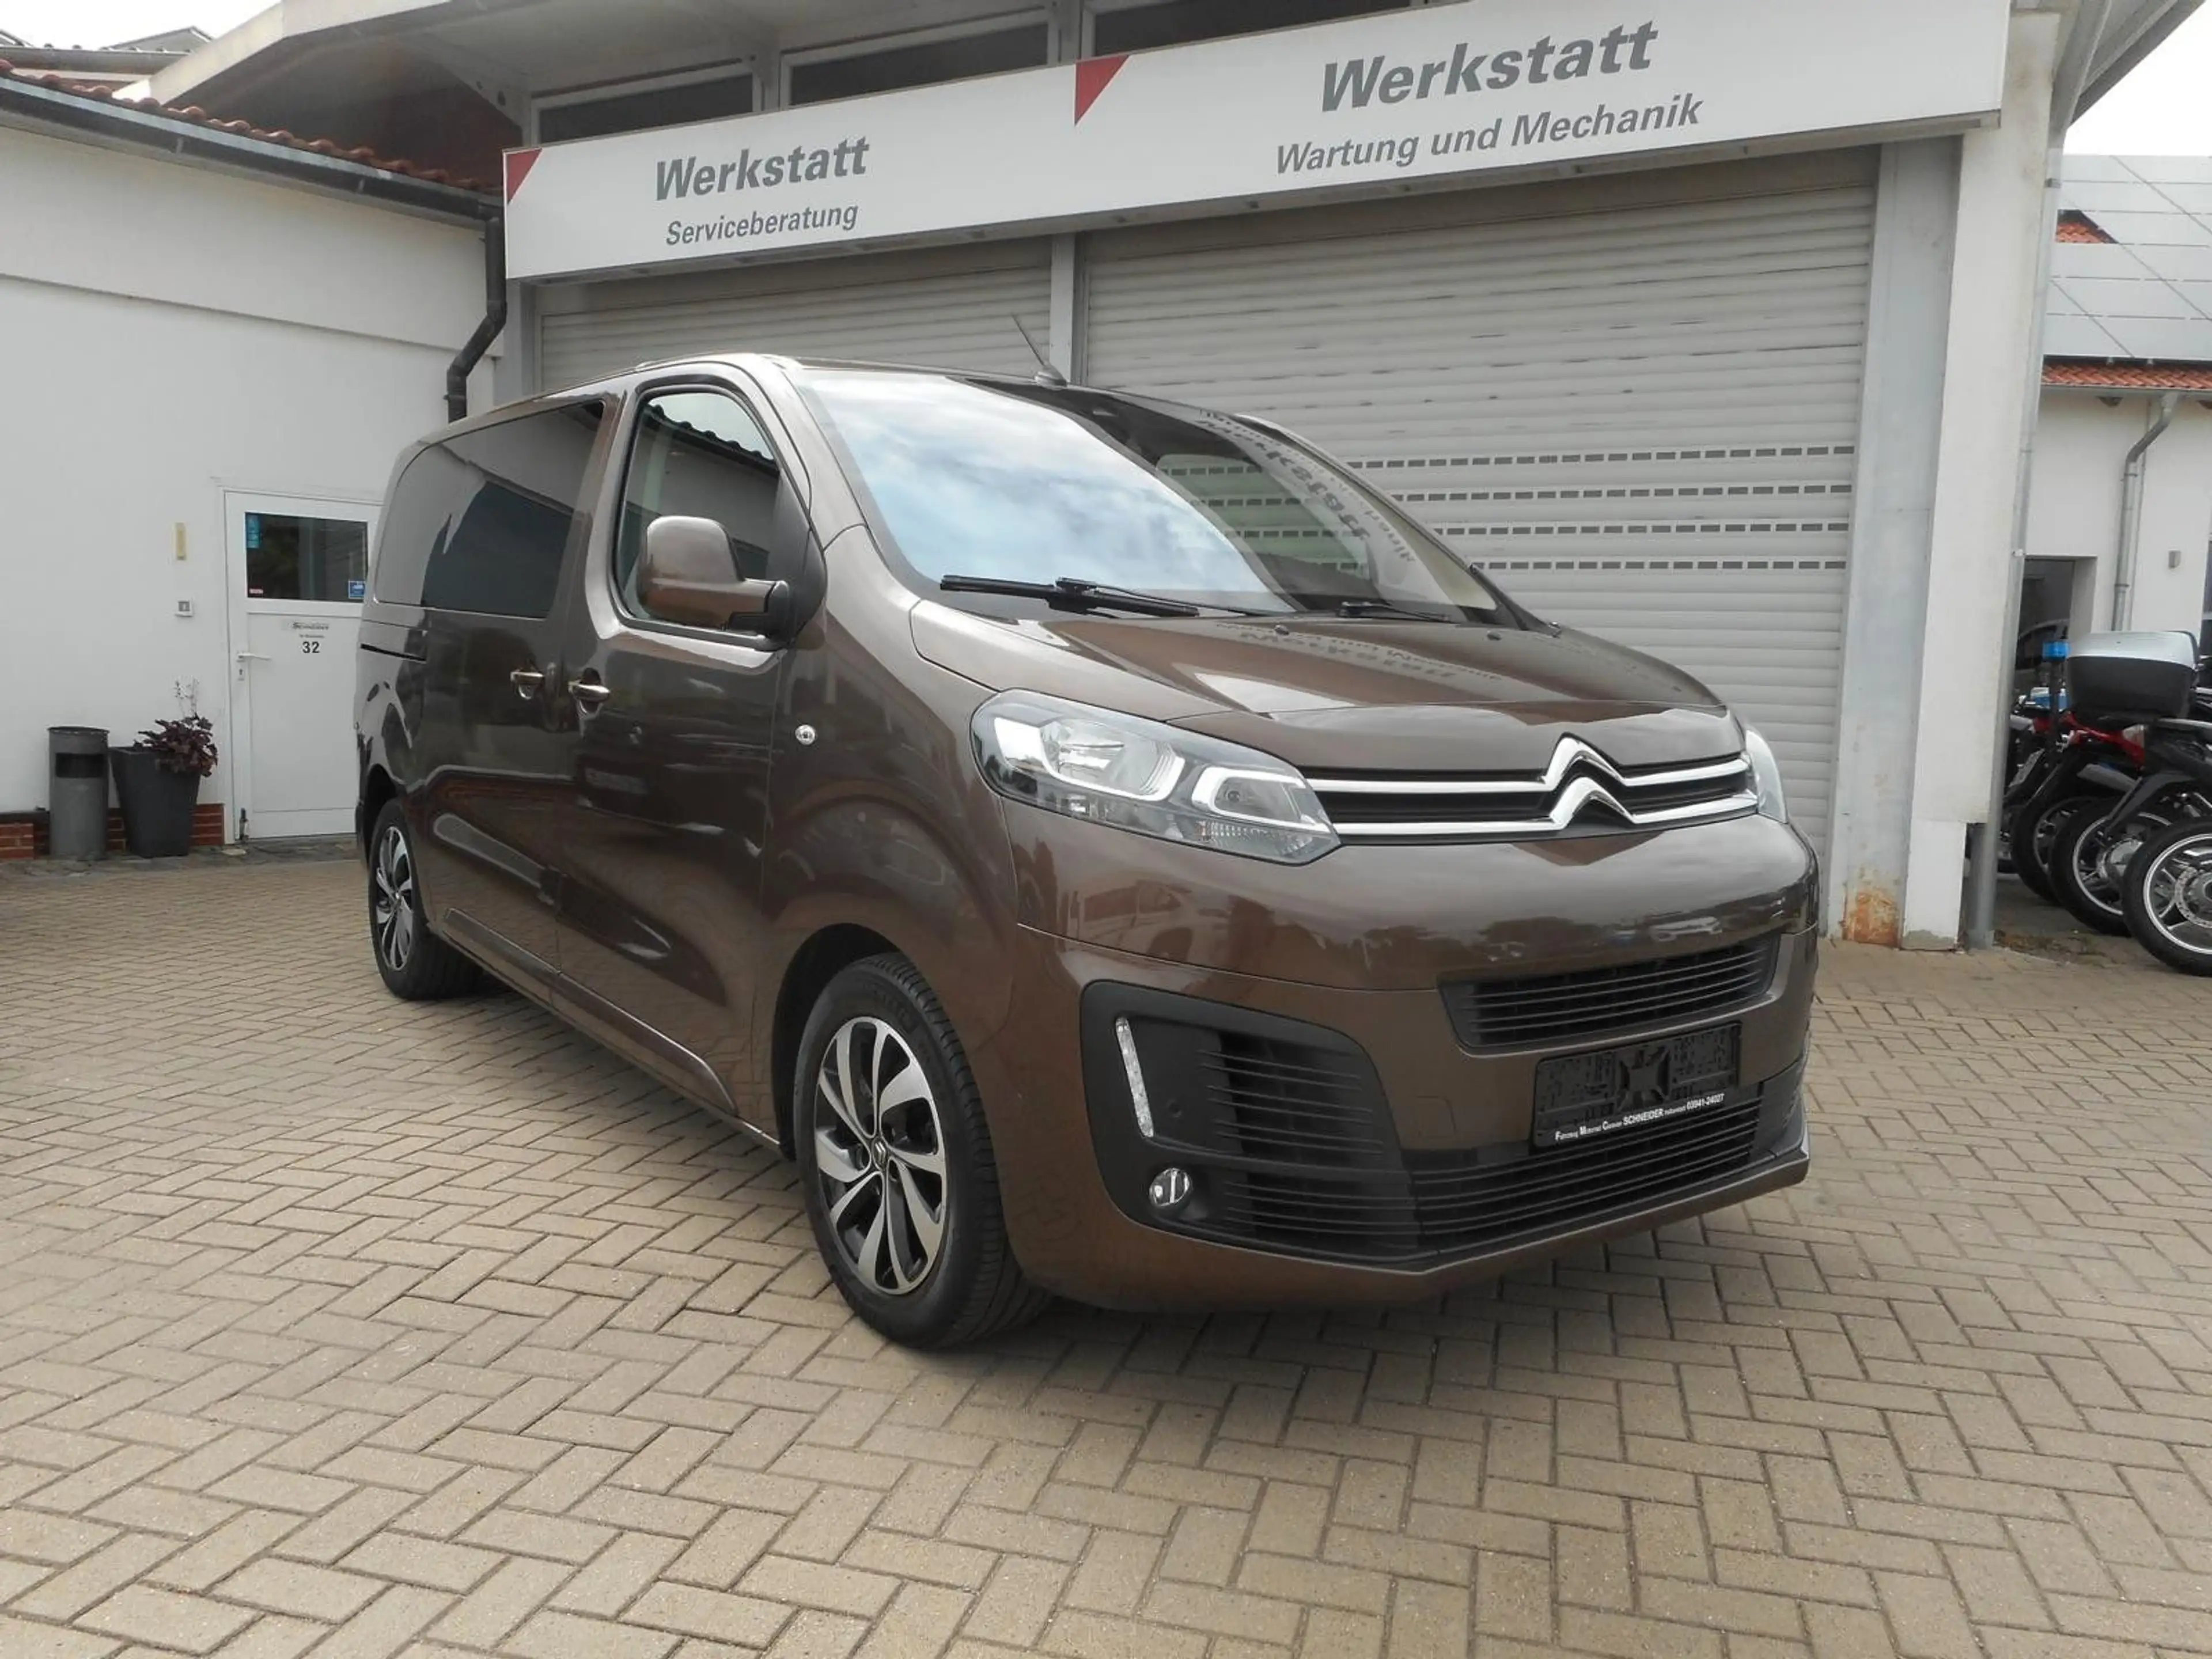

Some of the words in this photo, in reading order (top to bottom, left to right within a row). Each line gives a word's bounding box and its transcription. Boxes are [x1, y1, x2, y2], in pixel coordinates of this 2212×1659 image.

[1322, 20, 1658, 112] Werkstatt
[1278, 137, 1419, 174] Wartung
[1431, 118, 1502, 156] und
[1511, 93, 1703, 146] Mechanik
[657, 137, 870, 201] Werkstatt
[666, 206, 858, 245] Serviceberatung
[302, 641, 320, 653] 32
